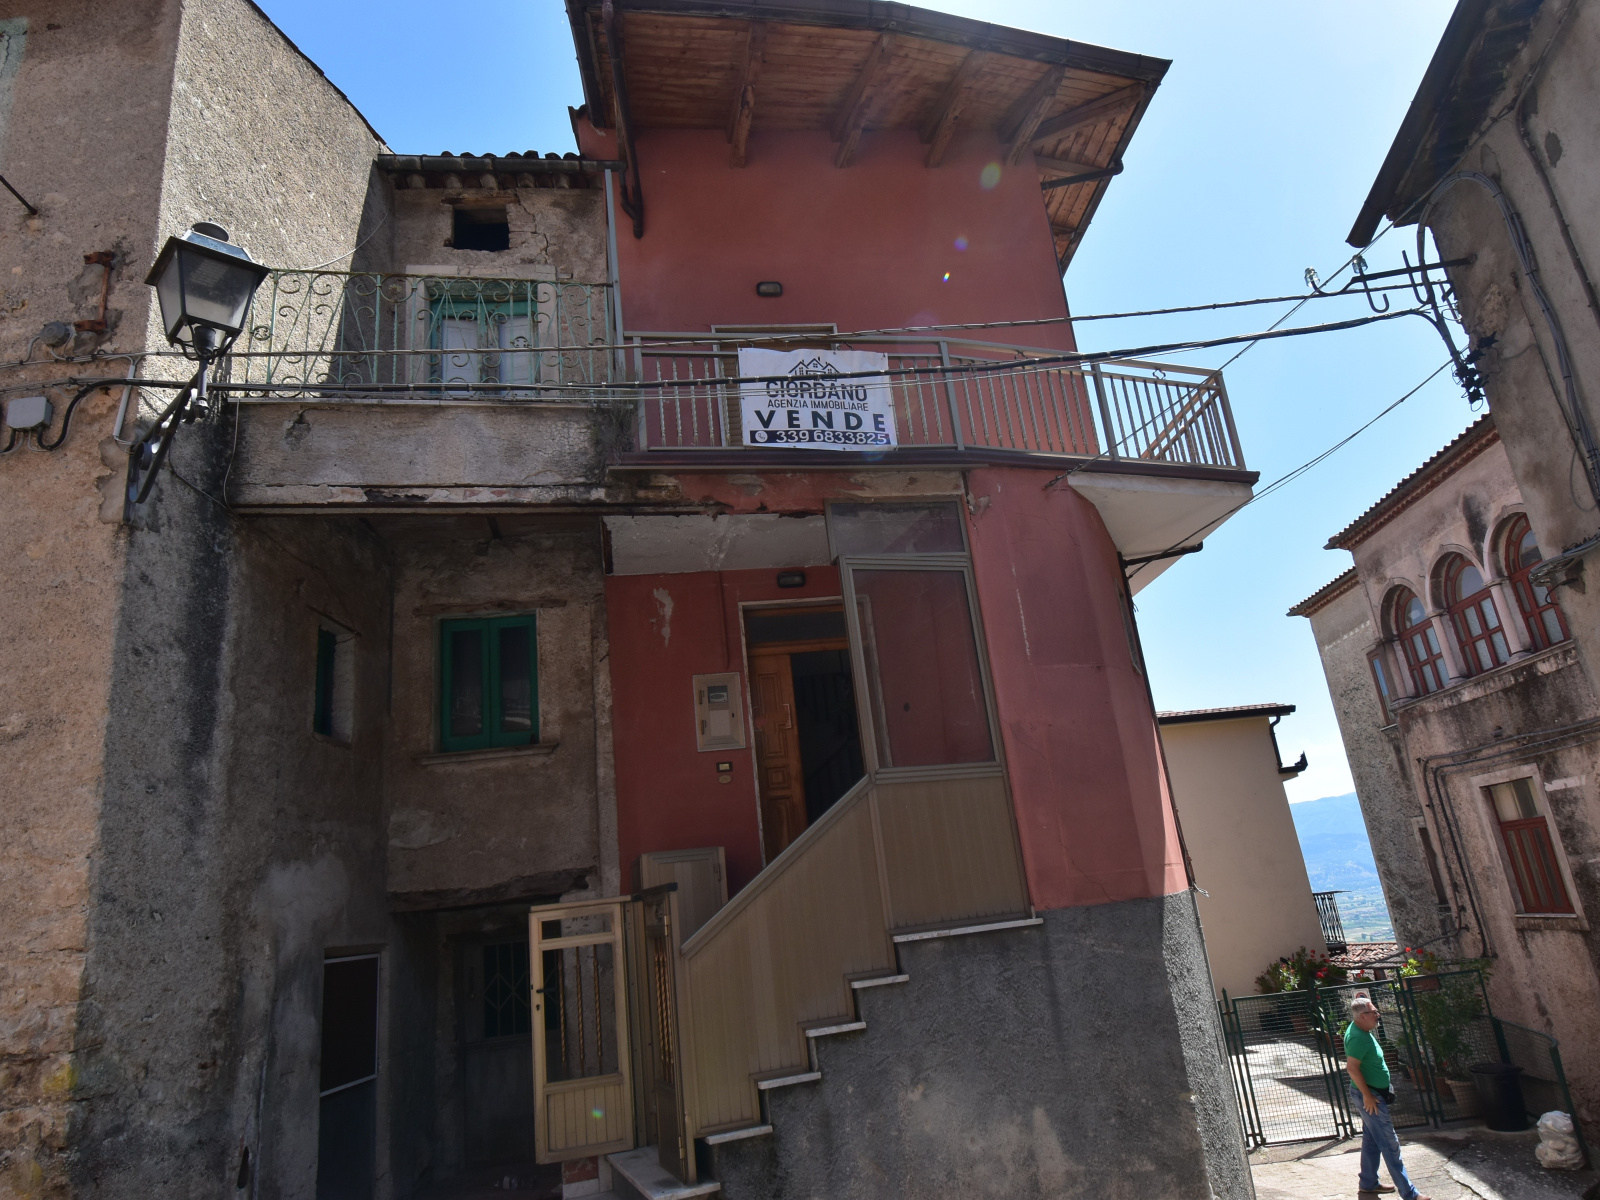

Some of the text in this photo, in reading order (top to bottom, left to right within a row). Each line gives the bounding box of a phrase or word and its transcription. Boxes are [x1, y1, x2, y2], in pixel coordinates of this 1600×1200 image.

[766, 380, 867, 402] GIORDANO
[767, 399, 869, 411] AGENZIA IMMOBILIARE
[754, 409, 886, 432] VENDE
[776, 430, 887, 444] 339 6833825
